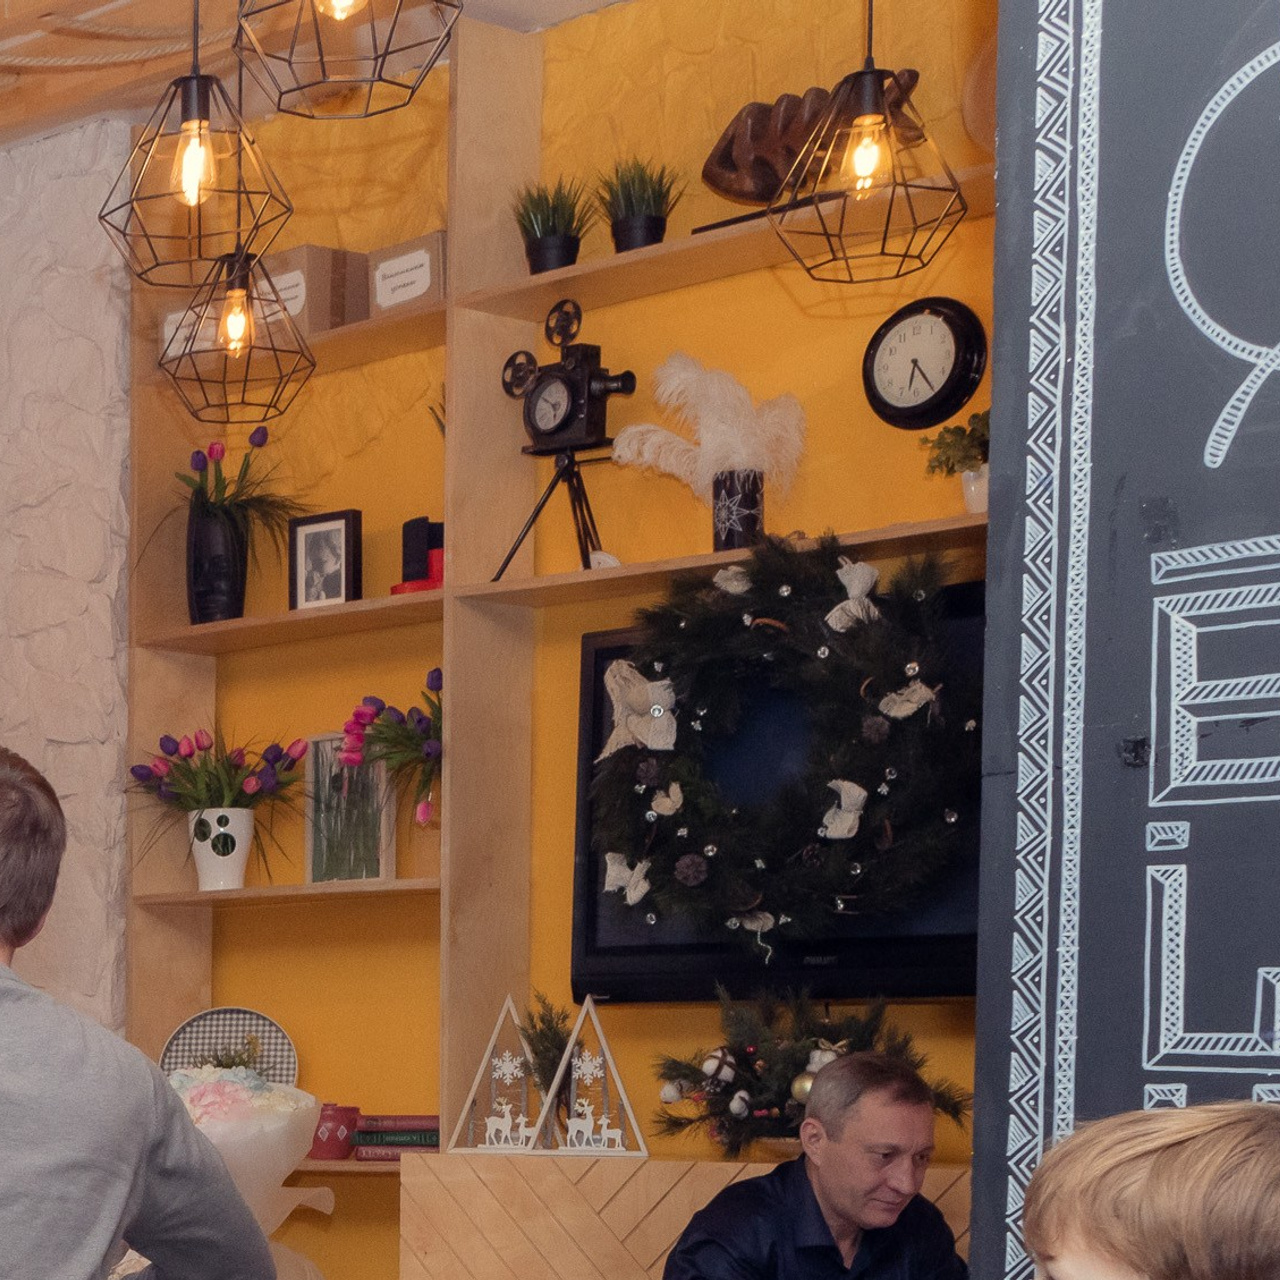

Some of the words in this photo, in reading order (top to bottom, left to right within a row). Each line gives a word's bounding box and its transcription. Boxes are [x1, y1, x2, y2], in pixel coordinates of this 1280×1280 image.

[911, 325, 922, 336] 12
[898, 333, 906, 343] 11
[939, 333, 947, 344] 2
[888, 346, 897, 356] 10
[887, 378, 893, 387] 8
[898, 387, 905, 397] 7
[913, 387, 920, 397] 6
